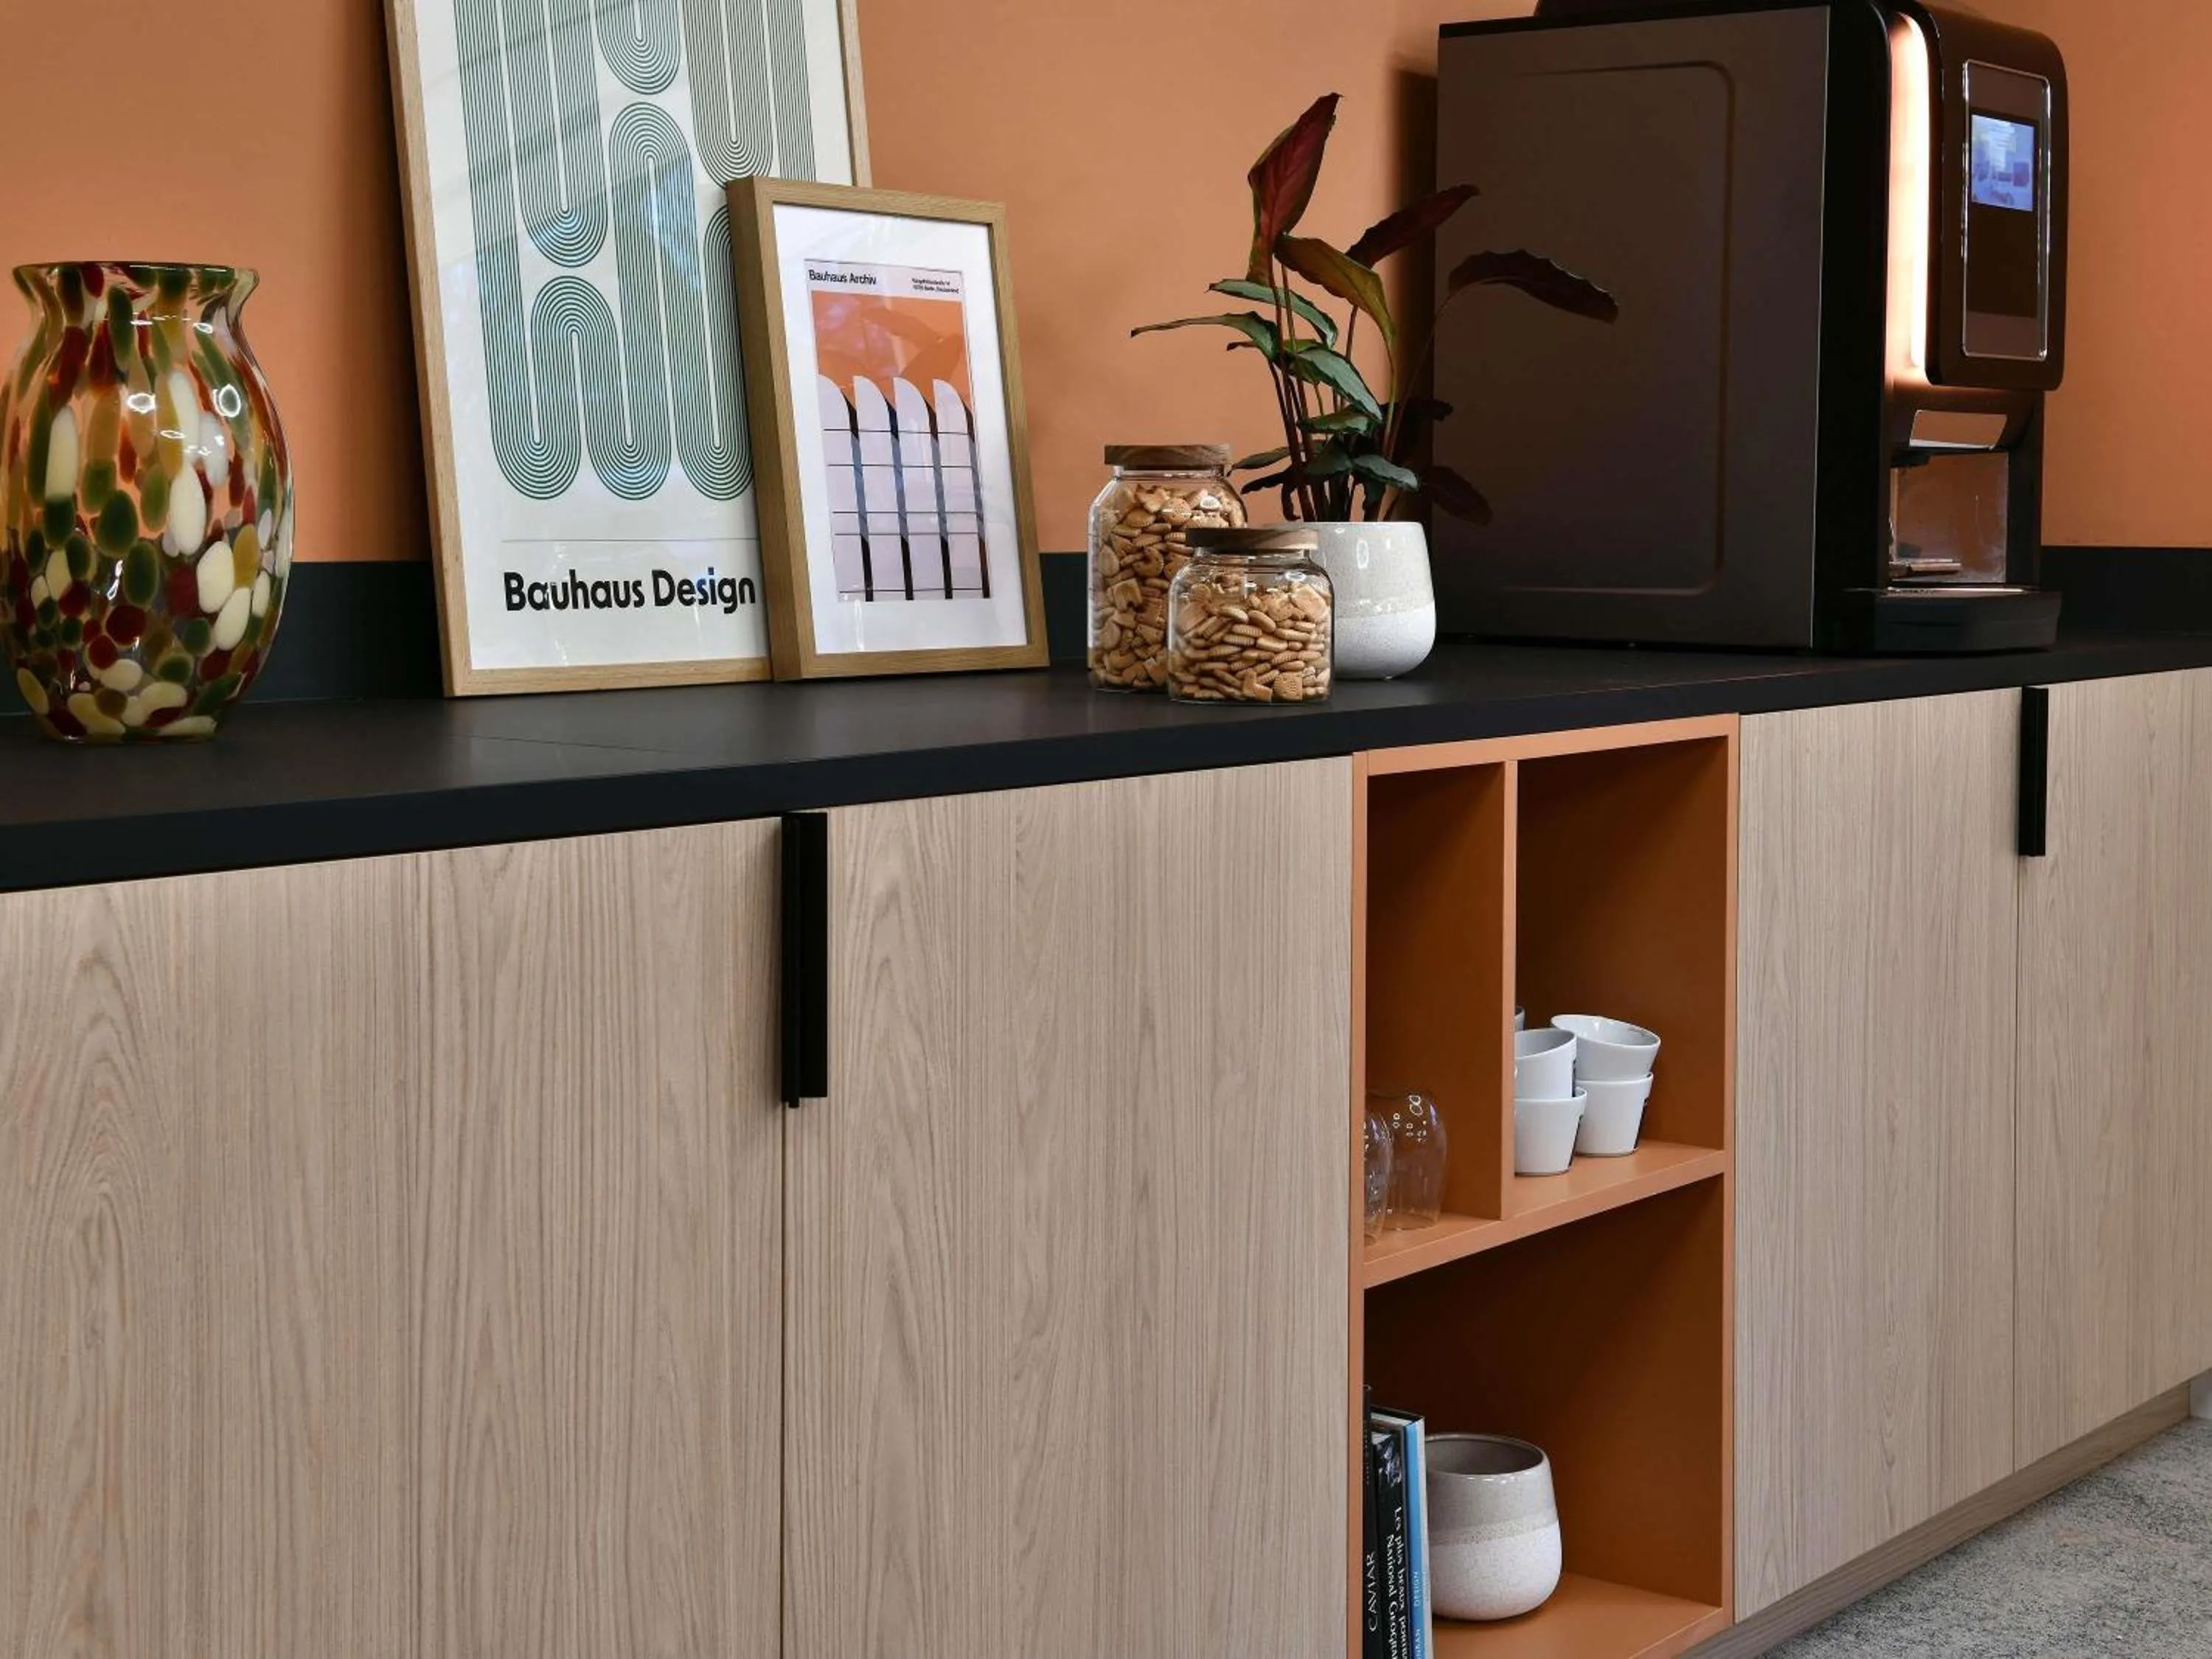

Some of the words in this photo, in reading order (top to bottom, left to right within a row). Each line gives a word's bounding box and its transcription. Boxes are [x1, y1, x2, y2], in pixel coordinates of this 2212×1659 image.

[808, 269, 848, 283] Bauhaus
[849, 273, 877, 285] Archiv
[504, 568, 645, 611] Bauhaus
[652, 567, 756, 613] Design
[1366, 1551, 1378, 1632] CAVIAR
[1412, 1571, 1421, 1607] DESIGN
